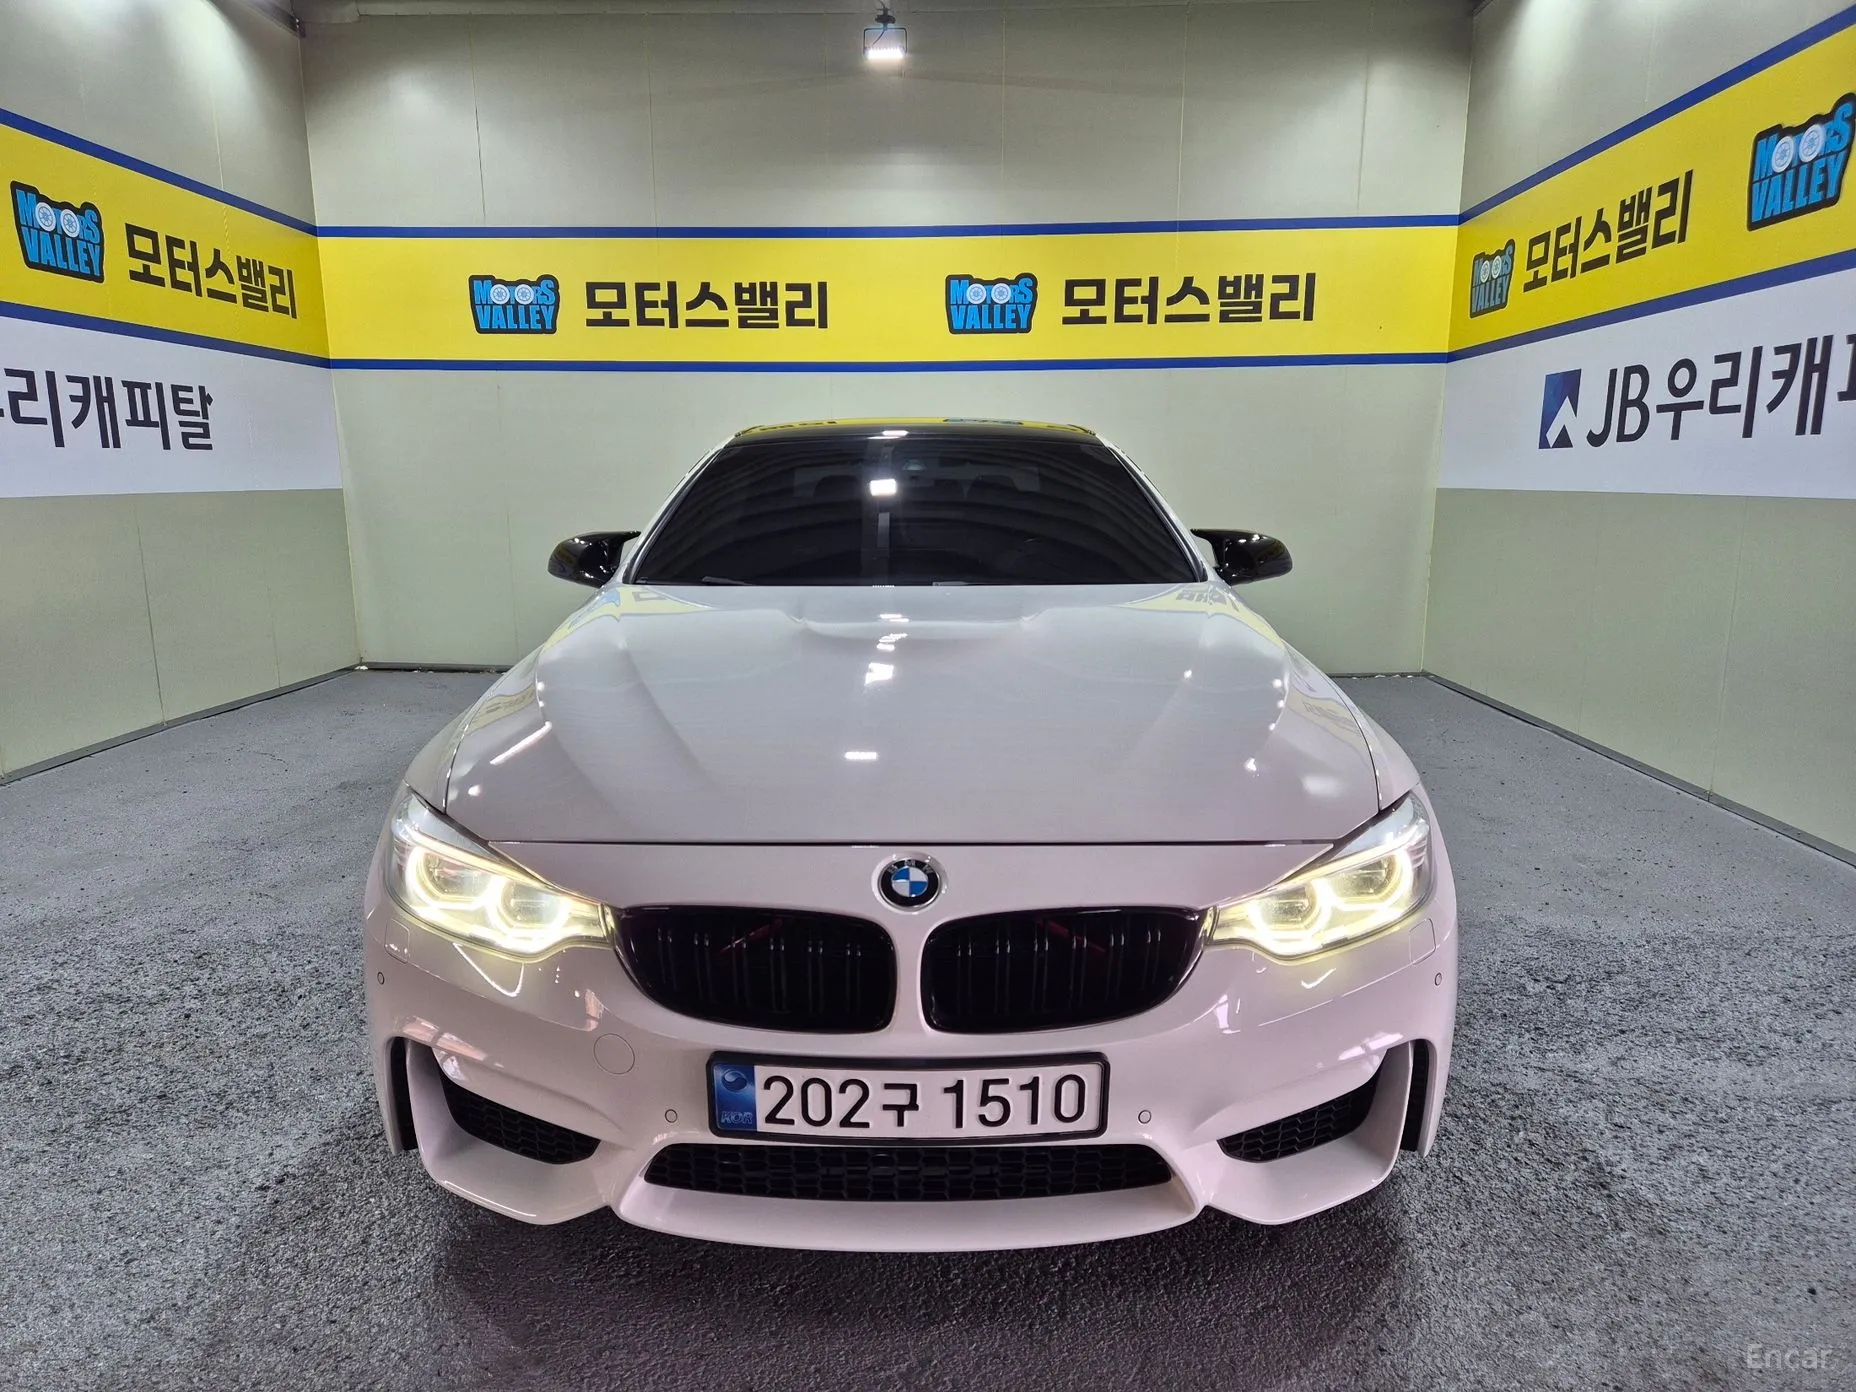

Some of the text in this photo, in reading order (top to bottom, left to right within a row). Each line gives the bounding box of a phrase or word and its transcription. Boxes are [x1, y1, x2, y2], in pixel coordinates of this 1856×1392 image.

[1751, 154, 1844, 222] VALLEY
[15, 189, 99, 243] MOTORS
[1523, 170, 1693, 292] 모터스밸리
[21, 225, 102, 277] VALLEY
[125, 222, 298, 319] 모터스밸리
[473, 279, 556, 305] MOTORS
[586, 281, 828, 329] 모터스밸리
[950, 277, 1034, 304] MOTORS
[1063, 273, 1316, 325] 모터스밸리
[1472, 273, 1511, 315] VALLEY
[475, 304, 555, 330] VALLEY
[950, 304, 1032, 330] VALLEY
[0, 367, 214, 451] 리캐피탈
[1586, 333, 1856, 448] JB우리캐
[887, 859, 934, 874] BMW
[720, 1111, 753, 1125] KOR
[763, 1073, 1087, 1129] 202구 1510
